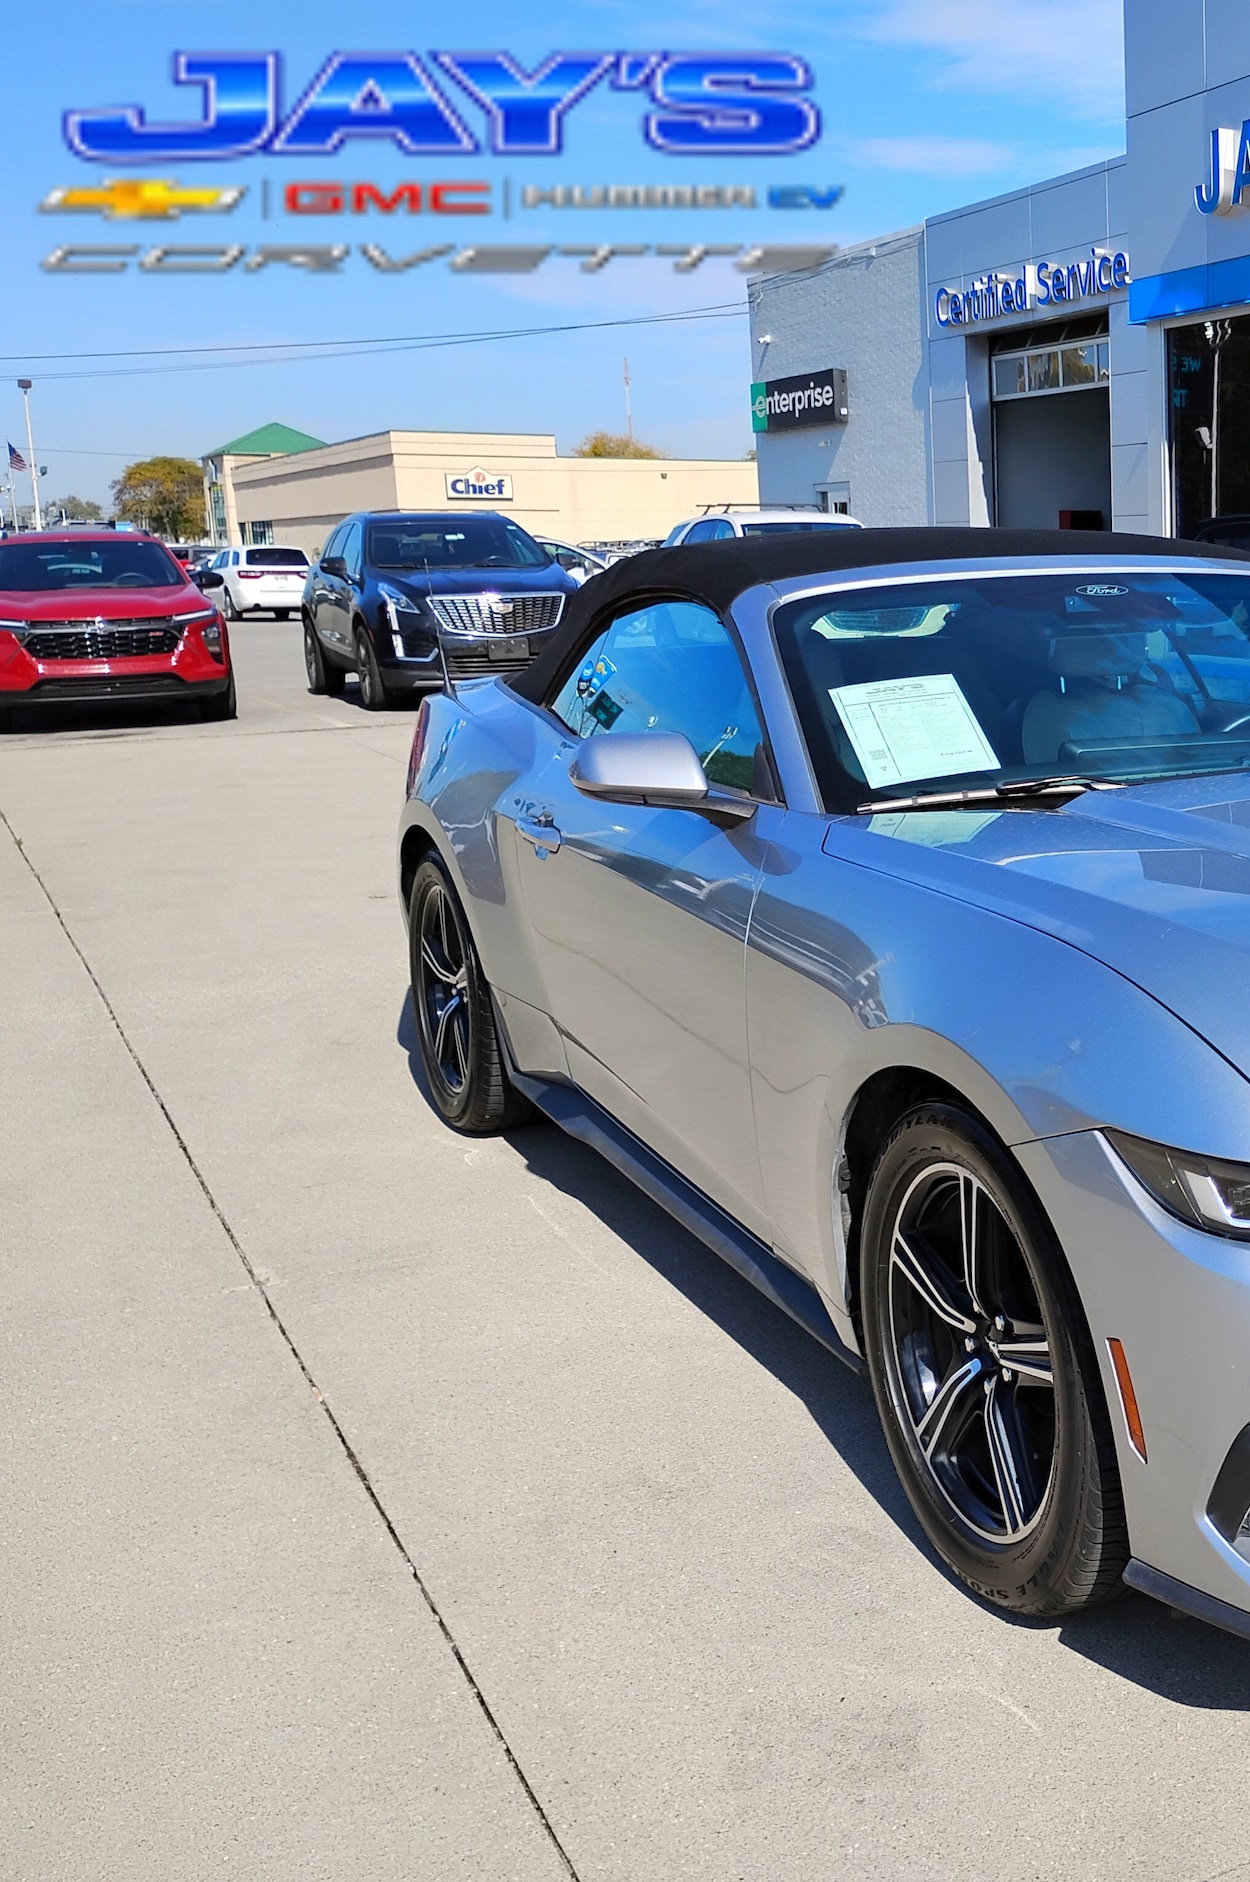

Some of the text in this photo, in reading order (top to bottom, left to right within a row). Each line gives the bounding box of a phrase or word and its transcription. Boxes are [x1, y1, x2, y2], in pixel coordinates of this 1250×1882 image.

[935, 247, 1131, 327] Certified Service
[752, 381, 833, 418] enterprise
[451, 479, 505, 495] Chief
[1086, 584, 1120, 595] Ford
